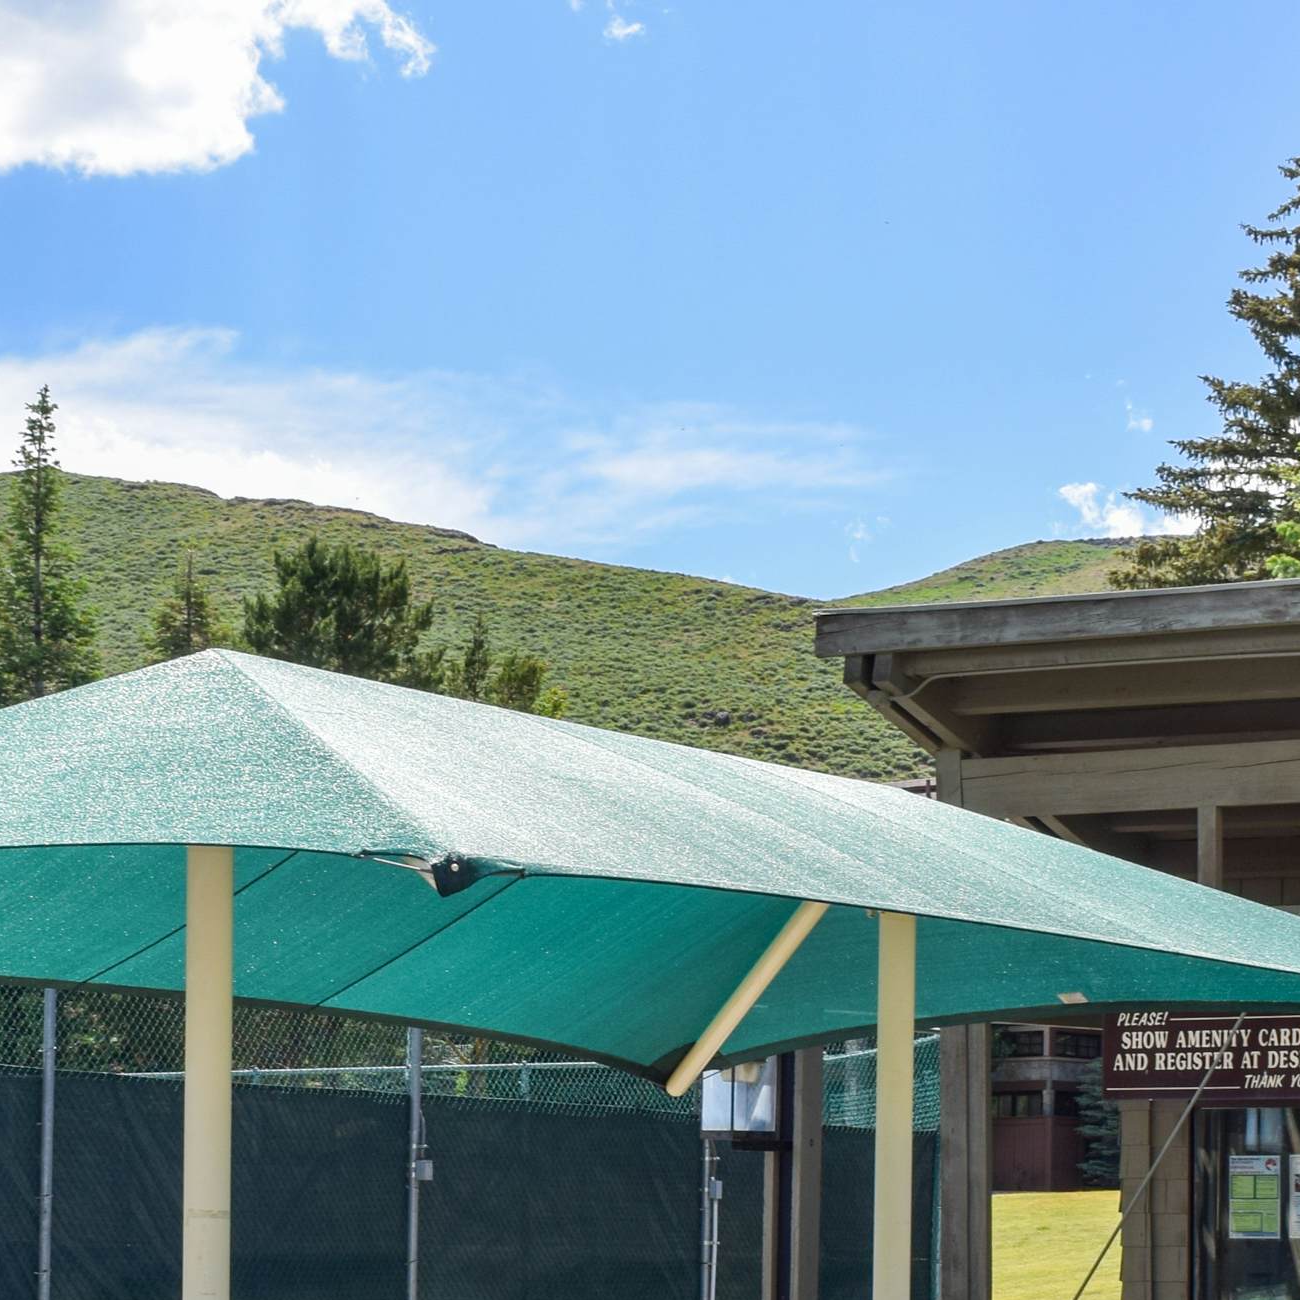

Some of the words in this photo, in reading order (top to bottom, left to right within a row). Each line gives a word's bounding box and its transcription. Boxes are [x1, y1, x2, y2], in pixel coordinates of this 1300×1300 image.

[1117, 1011, 1168, 1027] PLEASE!
[1121, 1031, 1169, 1050] SHOW
[1176, 1029, 1251, 1048] AMENITY
[1113, 1053, 1148, 1071] AND
[1154, 1052, 1233, 1070] REGISTER
[1241, 1052, 1260, 1069] AT
[1244, 1074, 1283, 1089] THANK
